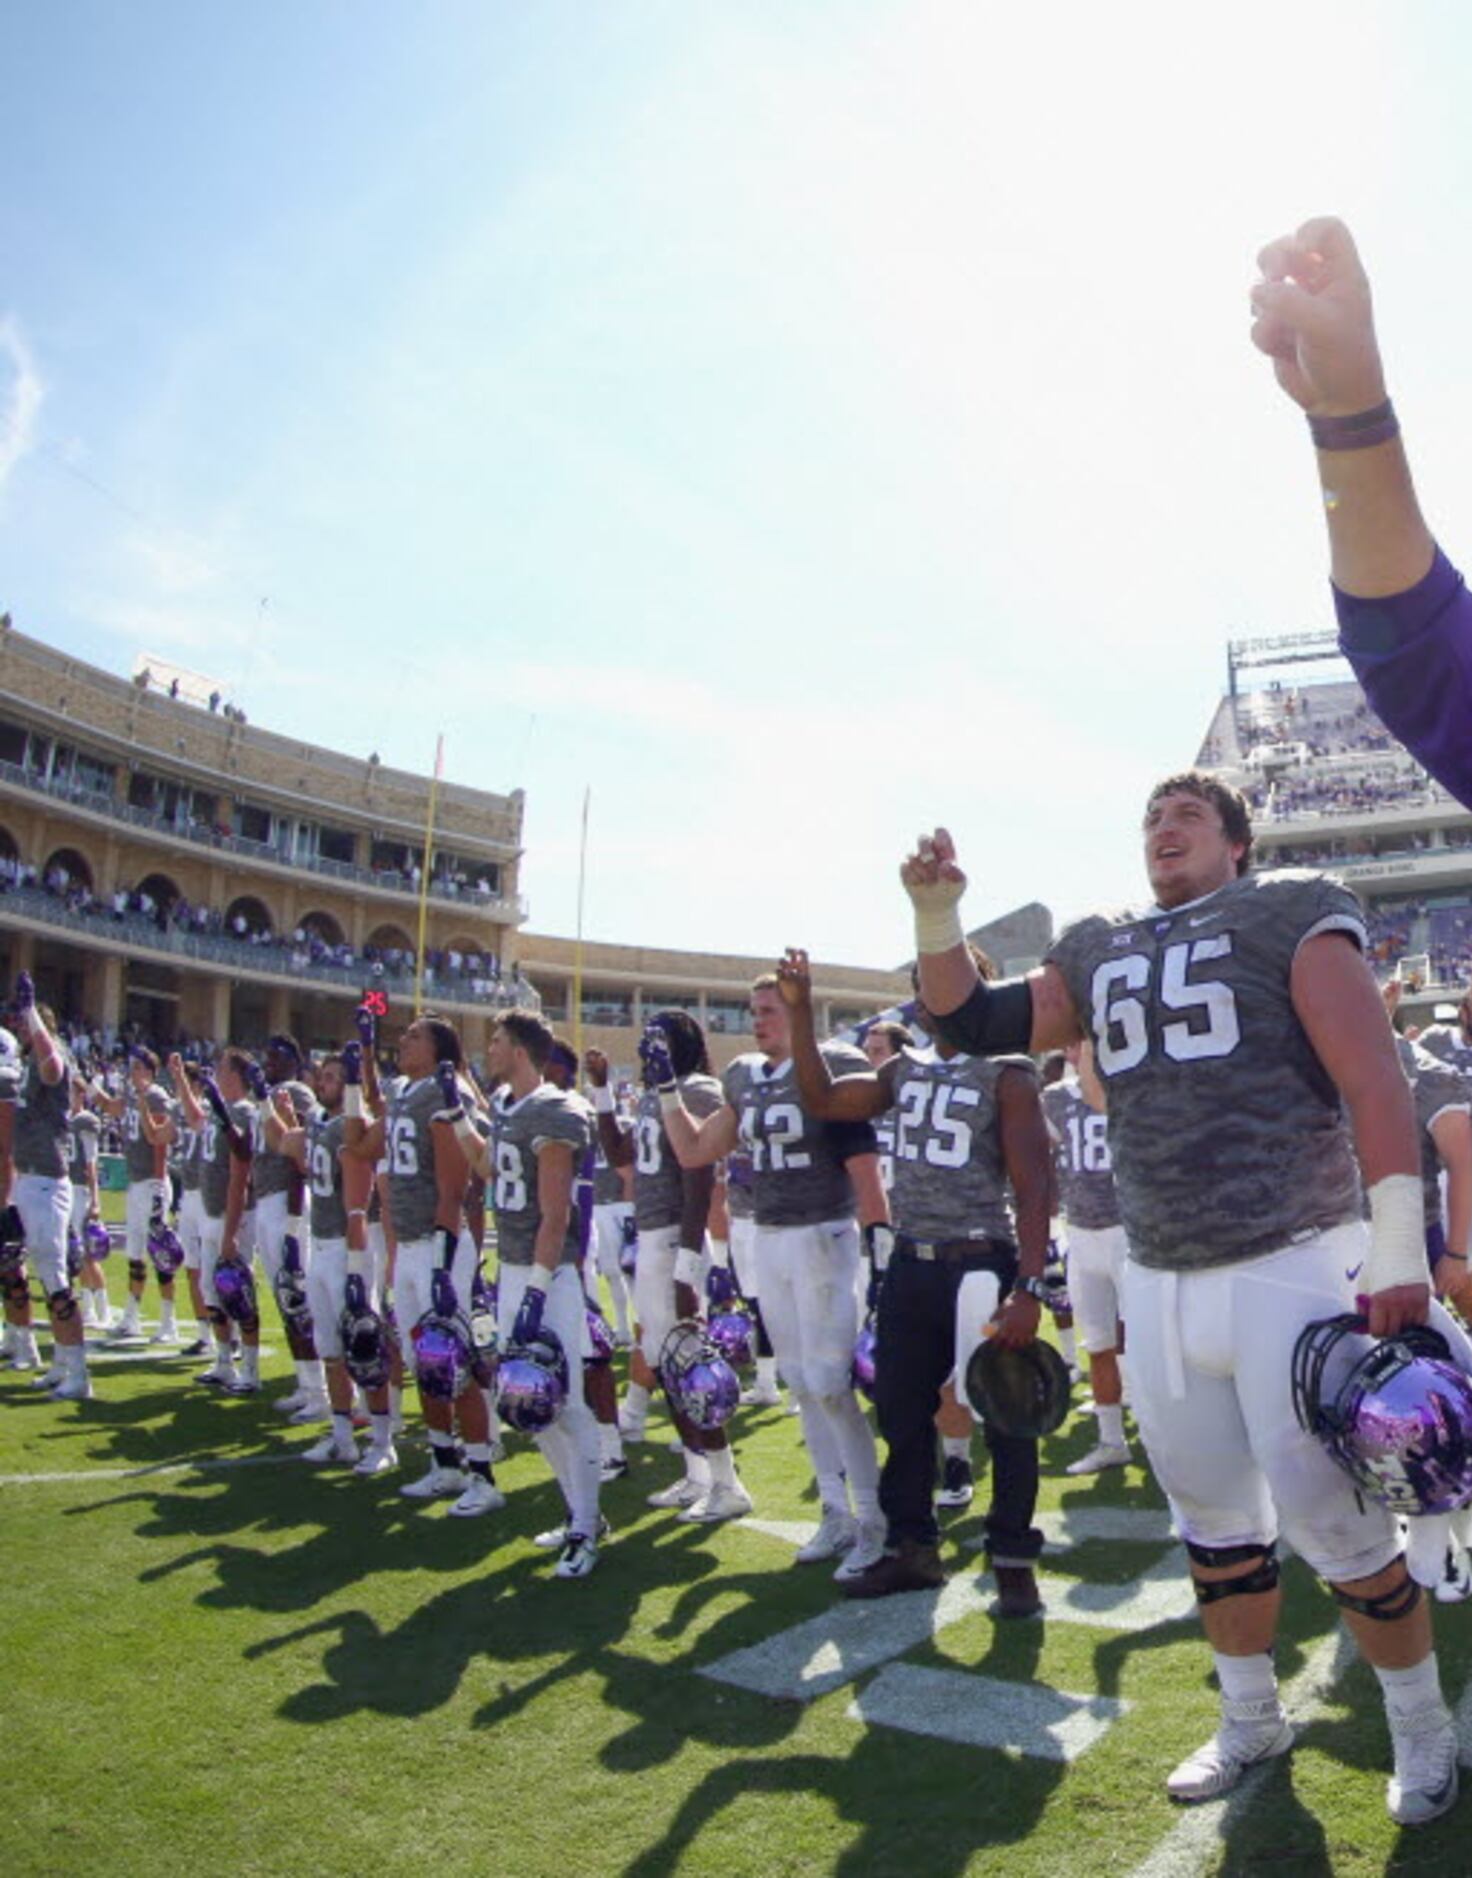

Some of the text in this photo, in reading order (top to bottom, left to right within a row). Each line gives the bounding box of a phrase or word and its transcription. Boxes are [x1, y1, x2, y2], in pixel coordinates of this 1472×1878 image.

[1092, 933, 1241, 1077] 65
[738, 1104, 811, 1172] 42
[897, 1081, 980, 1169] 25
[1066, 1114, 1113, 1171] 18
